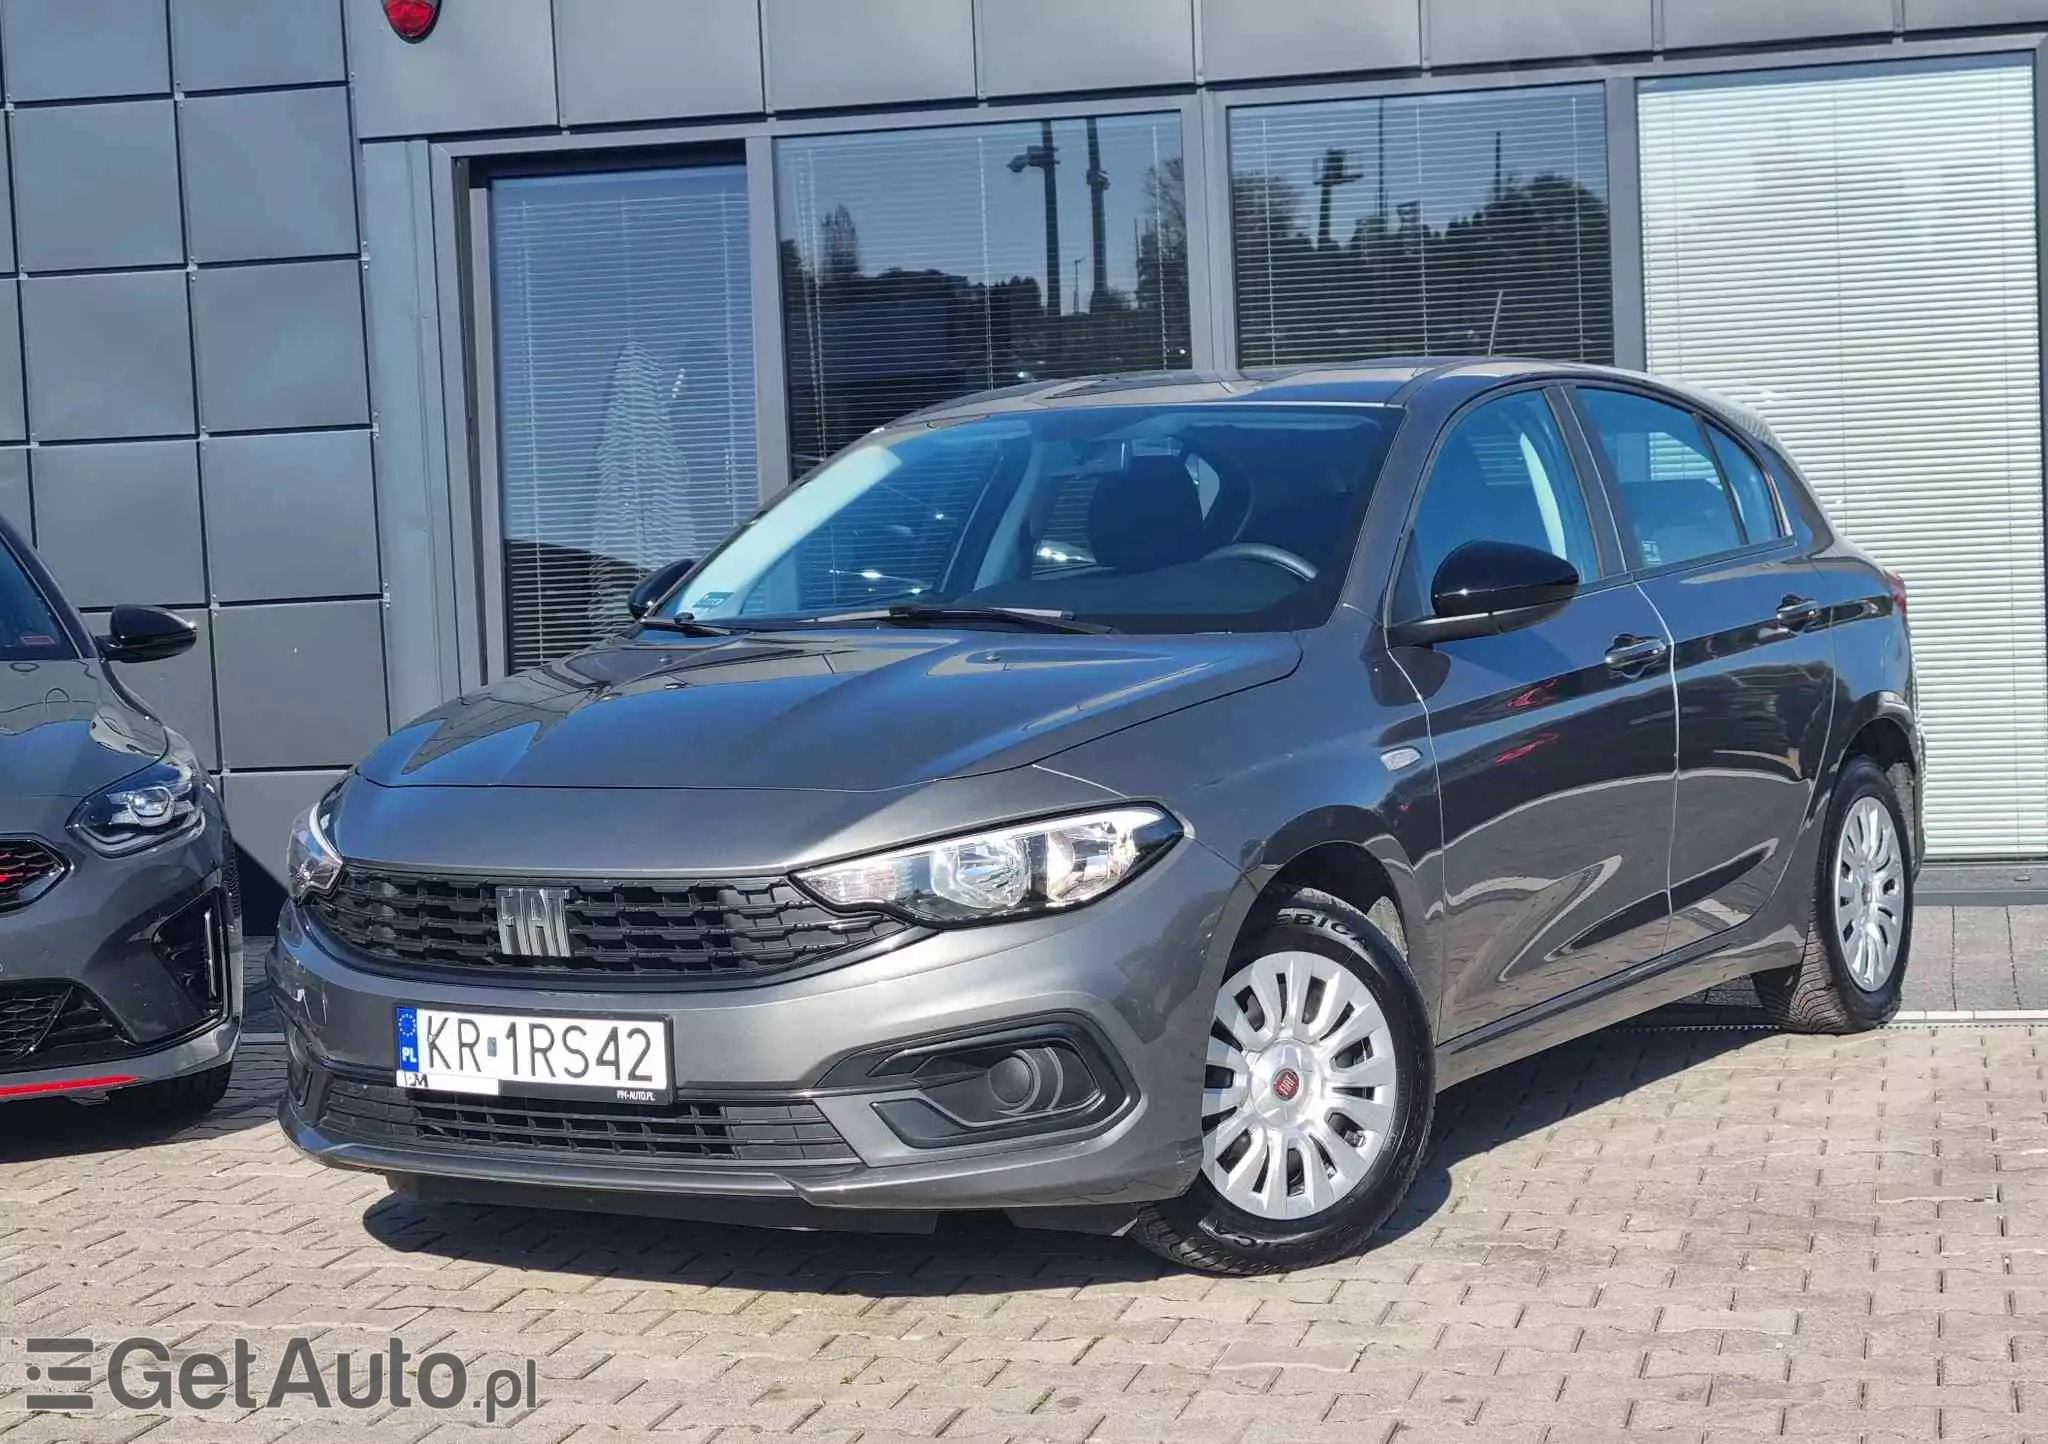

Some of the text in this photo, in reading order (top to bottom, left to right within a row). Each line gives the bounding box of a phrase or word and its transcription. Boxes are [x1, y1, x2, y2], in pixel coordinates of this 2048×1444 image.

[496, 887, 571, 957] FIAT
[401, 1046, 417, 1063] PL
[427, 1015, 653, 1082] KR 1RS42
